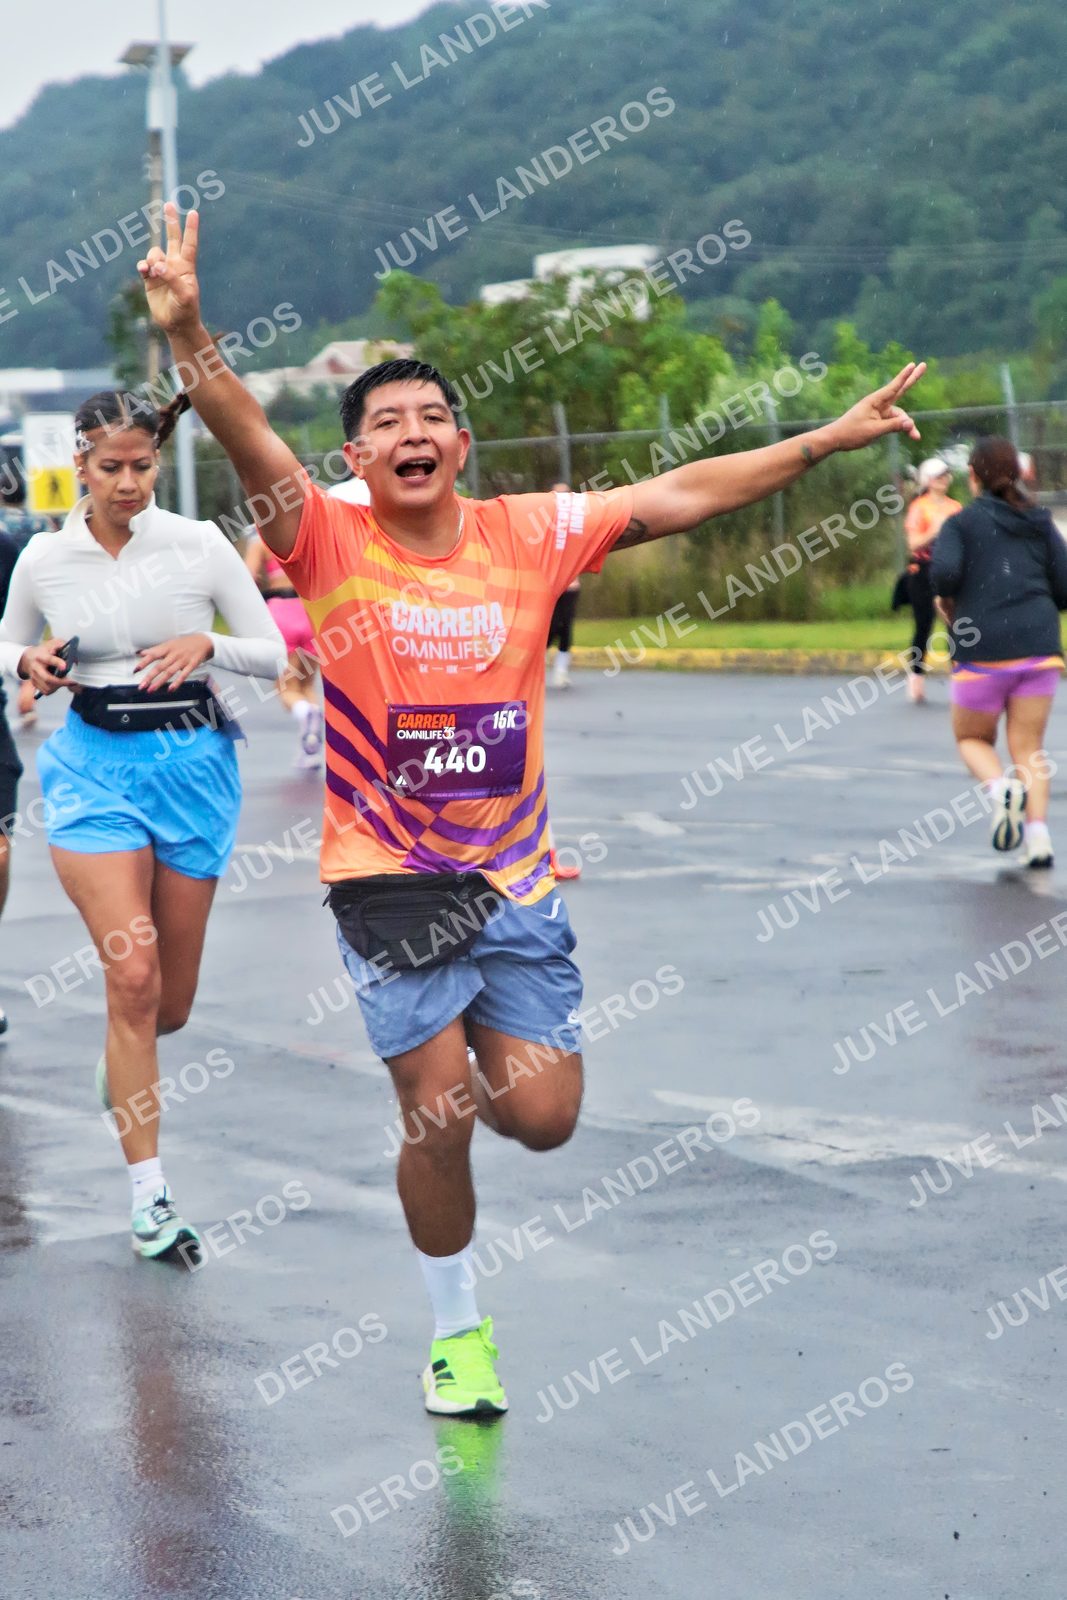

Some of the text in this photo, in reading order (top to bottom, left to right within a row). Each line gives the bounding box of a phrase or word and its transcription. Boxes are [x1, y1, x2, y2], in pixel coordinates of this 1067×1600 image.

[391, 601, 504, 637] CARRERA
[391, 636, 484, 660] OMNILIFE
[397, 713, 456, 728] CARRERA
[493, 709, 517, 729] 15K
[424, 745, 487, 774] 440
